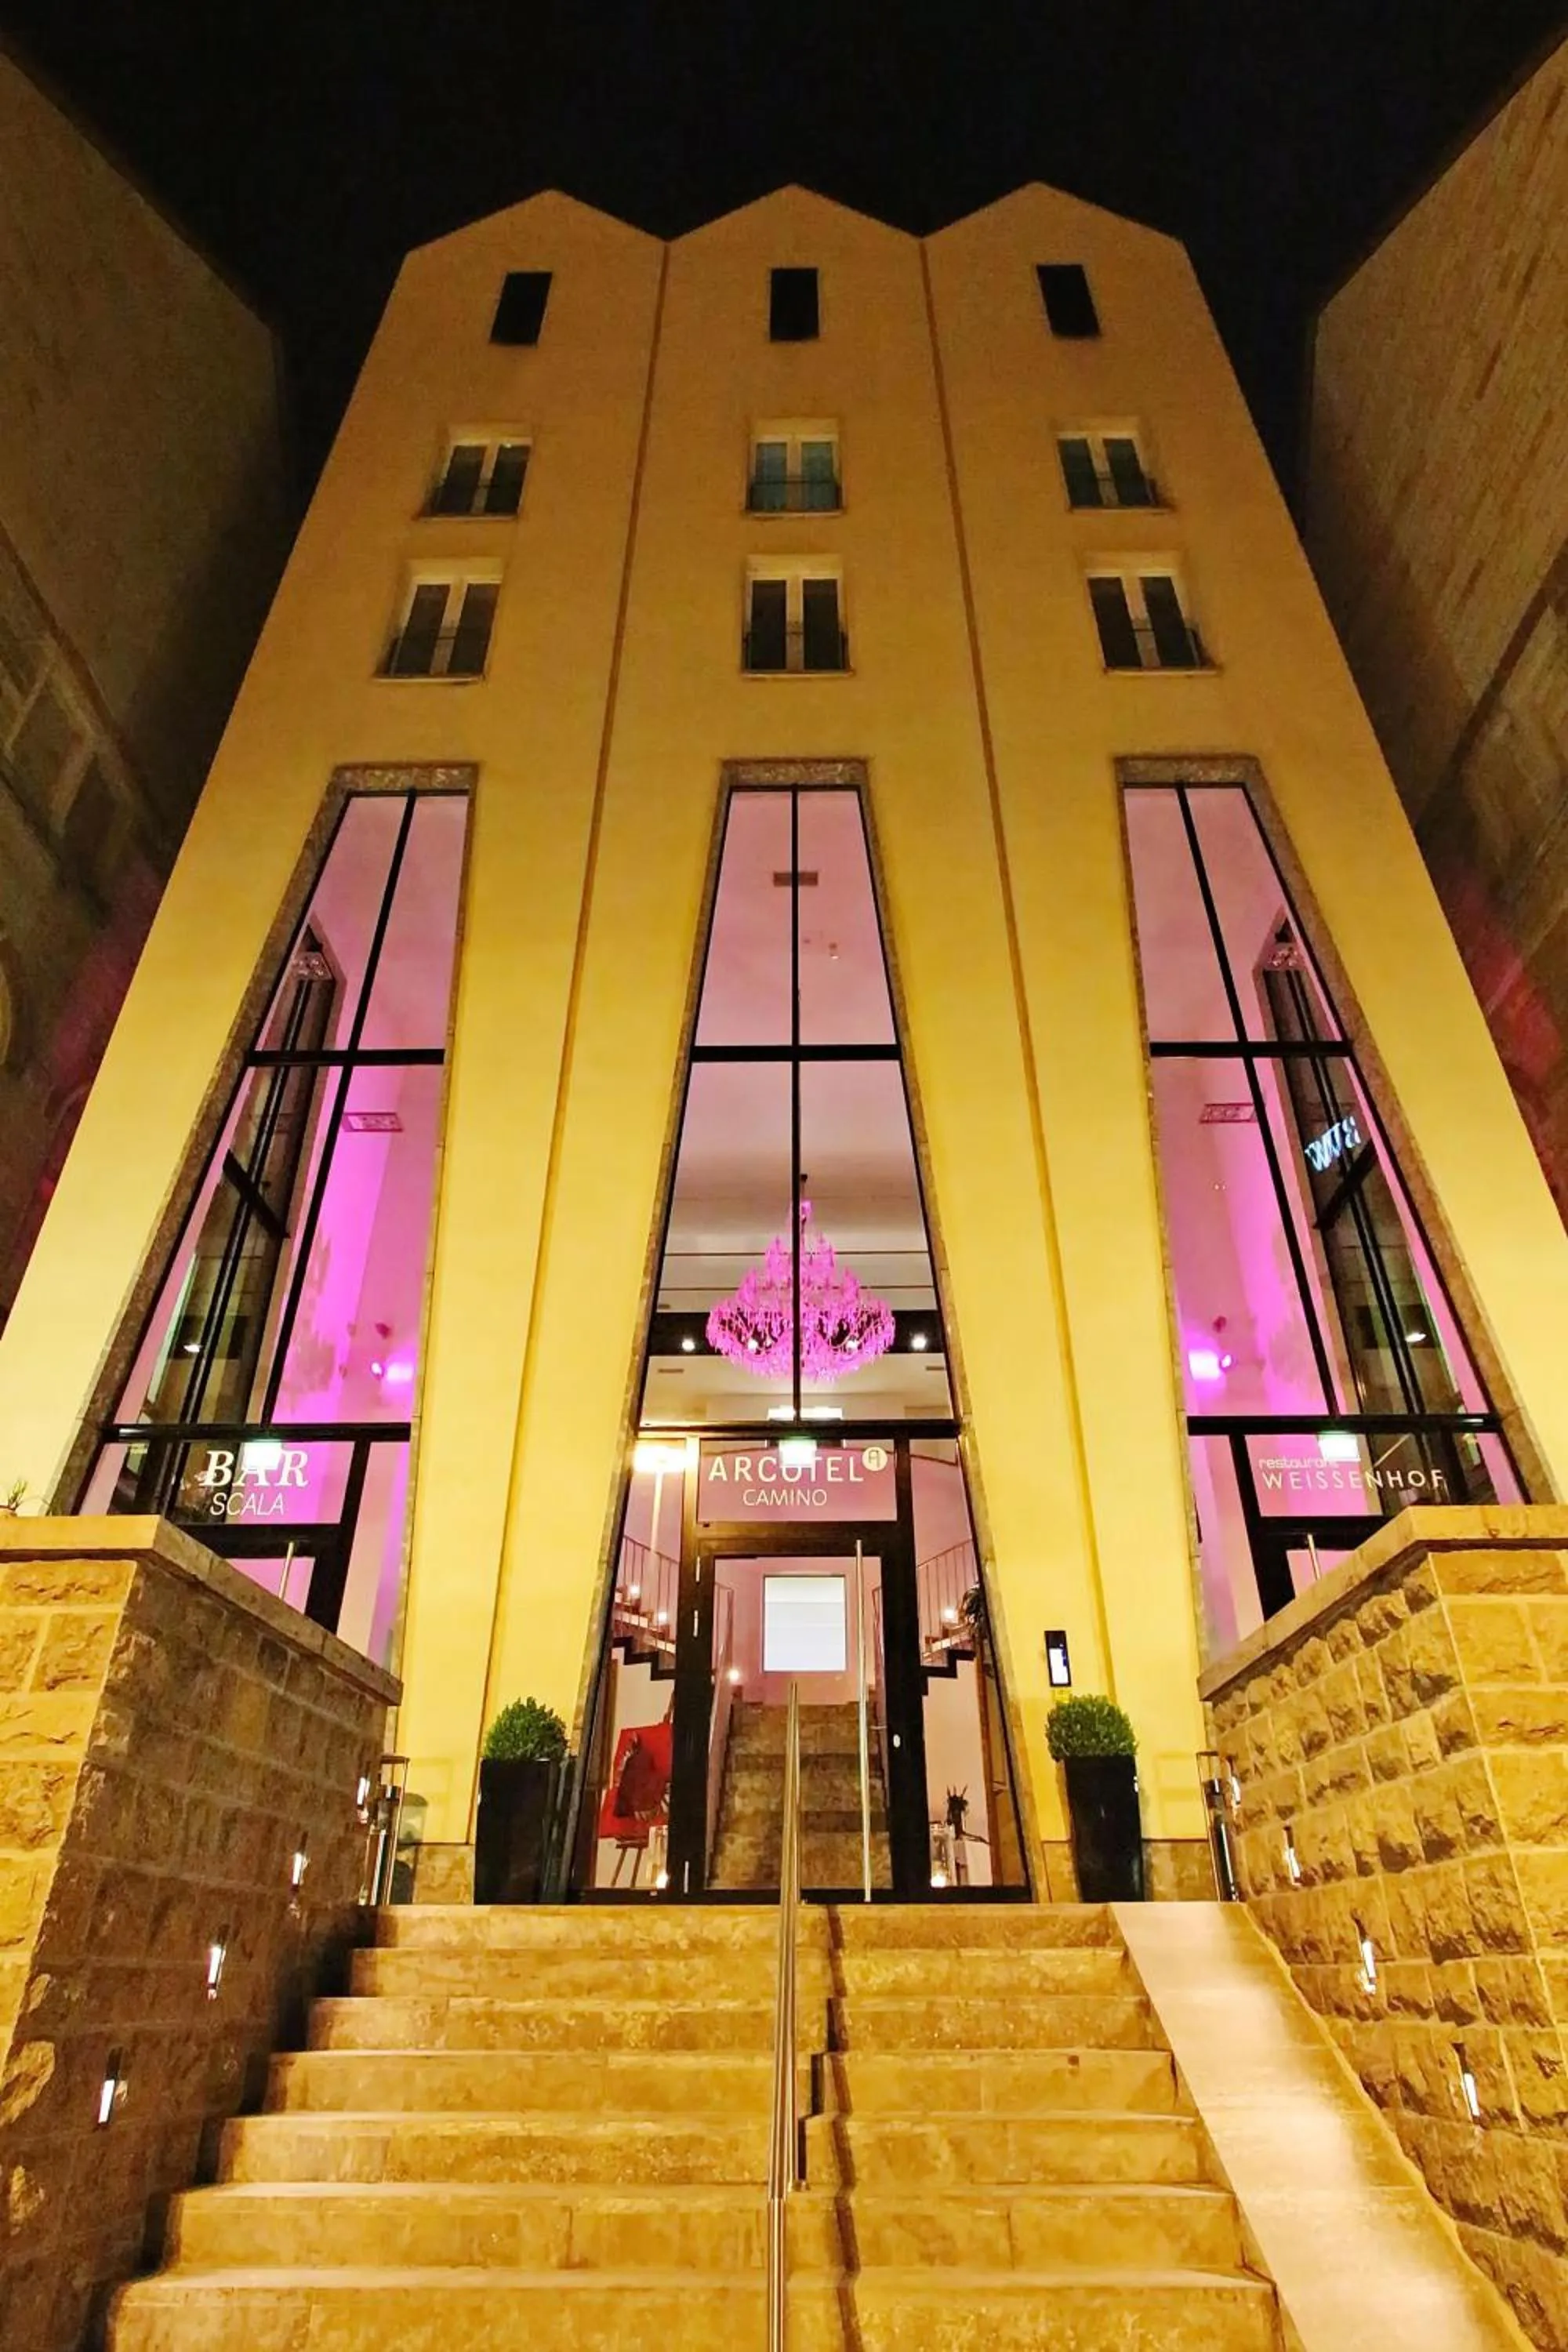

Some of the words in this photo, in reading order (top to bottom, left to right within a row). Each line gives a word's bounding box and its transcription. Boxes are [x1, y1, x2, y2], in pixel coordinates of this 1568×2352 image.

[199, 1450, 309, 1487] BAR
[708, 1456, 863, 1482] ARCOTEL
[1262, 1469, 1443, 1489] WEISSENHOF
[210, 1493, 285, 1515] SCALA
[743, 1490, 827, 1506] CAMINO
